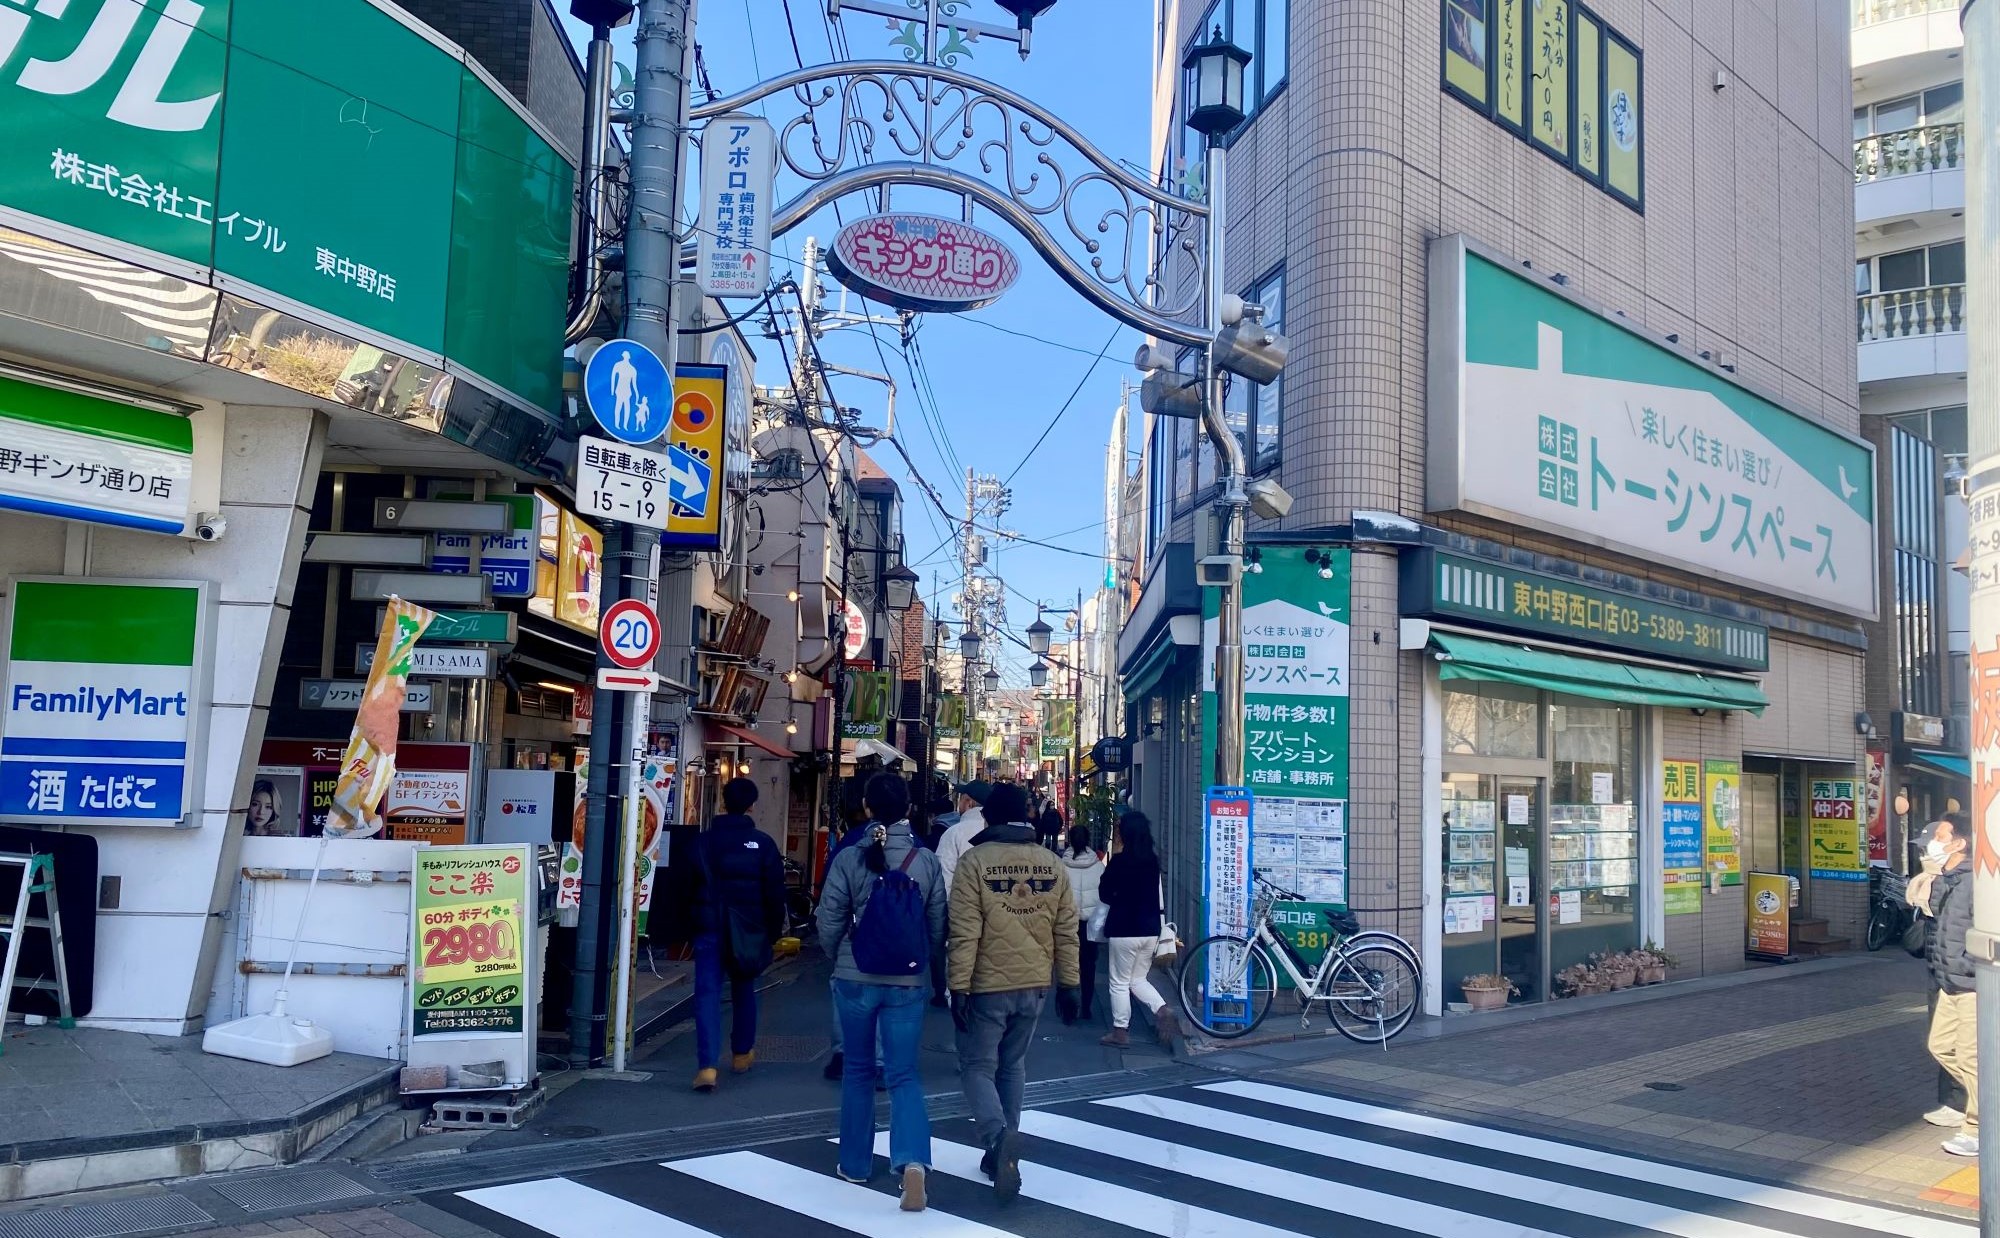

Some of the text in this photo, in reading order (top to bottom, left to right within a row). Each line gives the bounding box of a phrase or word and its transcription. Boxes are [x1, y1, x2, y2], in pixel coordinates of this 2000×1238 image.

[728, 125, 750, 189] アポロ
[50, 147, 287, 254] 株式会社エイブル
[716, 193, 735, 249] 専門学校
[738, 192, 756, 250] 歯科衛生士
[855, 223, 1002, 288] ギンザ通り
[315, 246, 397, 301] 東中野店
[710, 279, 756, 289] 3385-0814
[1641, 406, 1771, 488] 楽しく住まい選び
[585, 444, 666, 480] 自転車を除く
[385, 506, 396, 520] 6
[592, 489, 656, 520] 15-19
[1589, 436, 1837, 583] トーシンスペース
[436, 533, 528, 552] FamyMart
[1512, 580, 1722, 650] 東中野西口店 03-5389-3811
[615, 618, 649, 650] 20
[1248, 645, 1306, 658] 株式会社
[12, 682, 187, 721] FamilyMart
[309, 685, 320, 700] 2
[1250, 730, 1317, 748] アパート
[1250, 746, 1334, 764] マンション
[27, 768, 157, 813] 酒 たばこ
[396, 780, 459, 790] 不動産のことなら
[1664, 765, 1698, 798] 売買
[1813, 781, 1853, 799] 売買
[515, 803, 537, 815] 松屋
[1216, 807, 1242, 816] お知らせ
[1813, 800, 1853, 819] 仲介
[1834, 841, 1847, 850] 2F
[504, 859, 519, 870] 2F
[986, 865, 1053, 875] SETAGAYA BASE
[428, 870, 495, 896] ここ楽
[424, 907, 491, 925] 60分 ボディ
[1273, 909, 1317, 925] 西口店
[421, 986, 518, 1005] ヘッド アロマ 足ツボ ボディ
